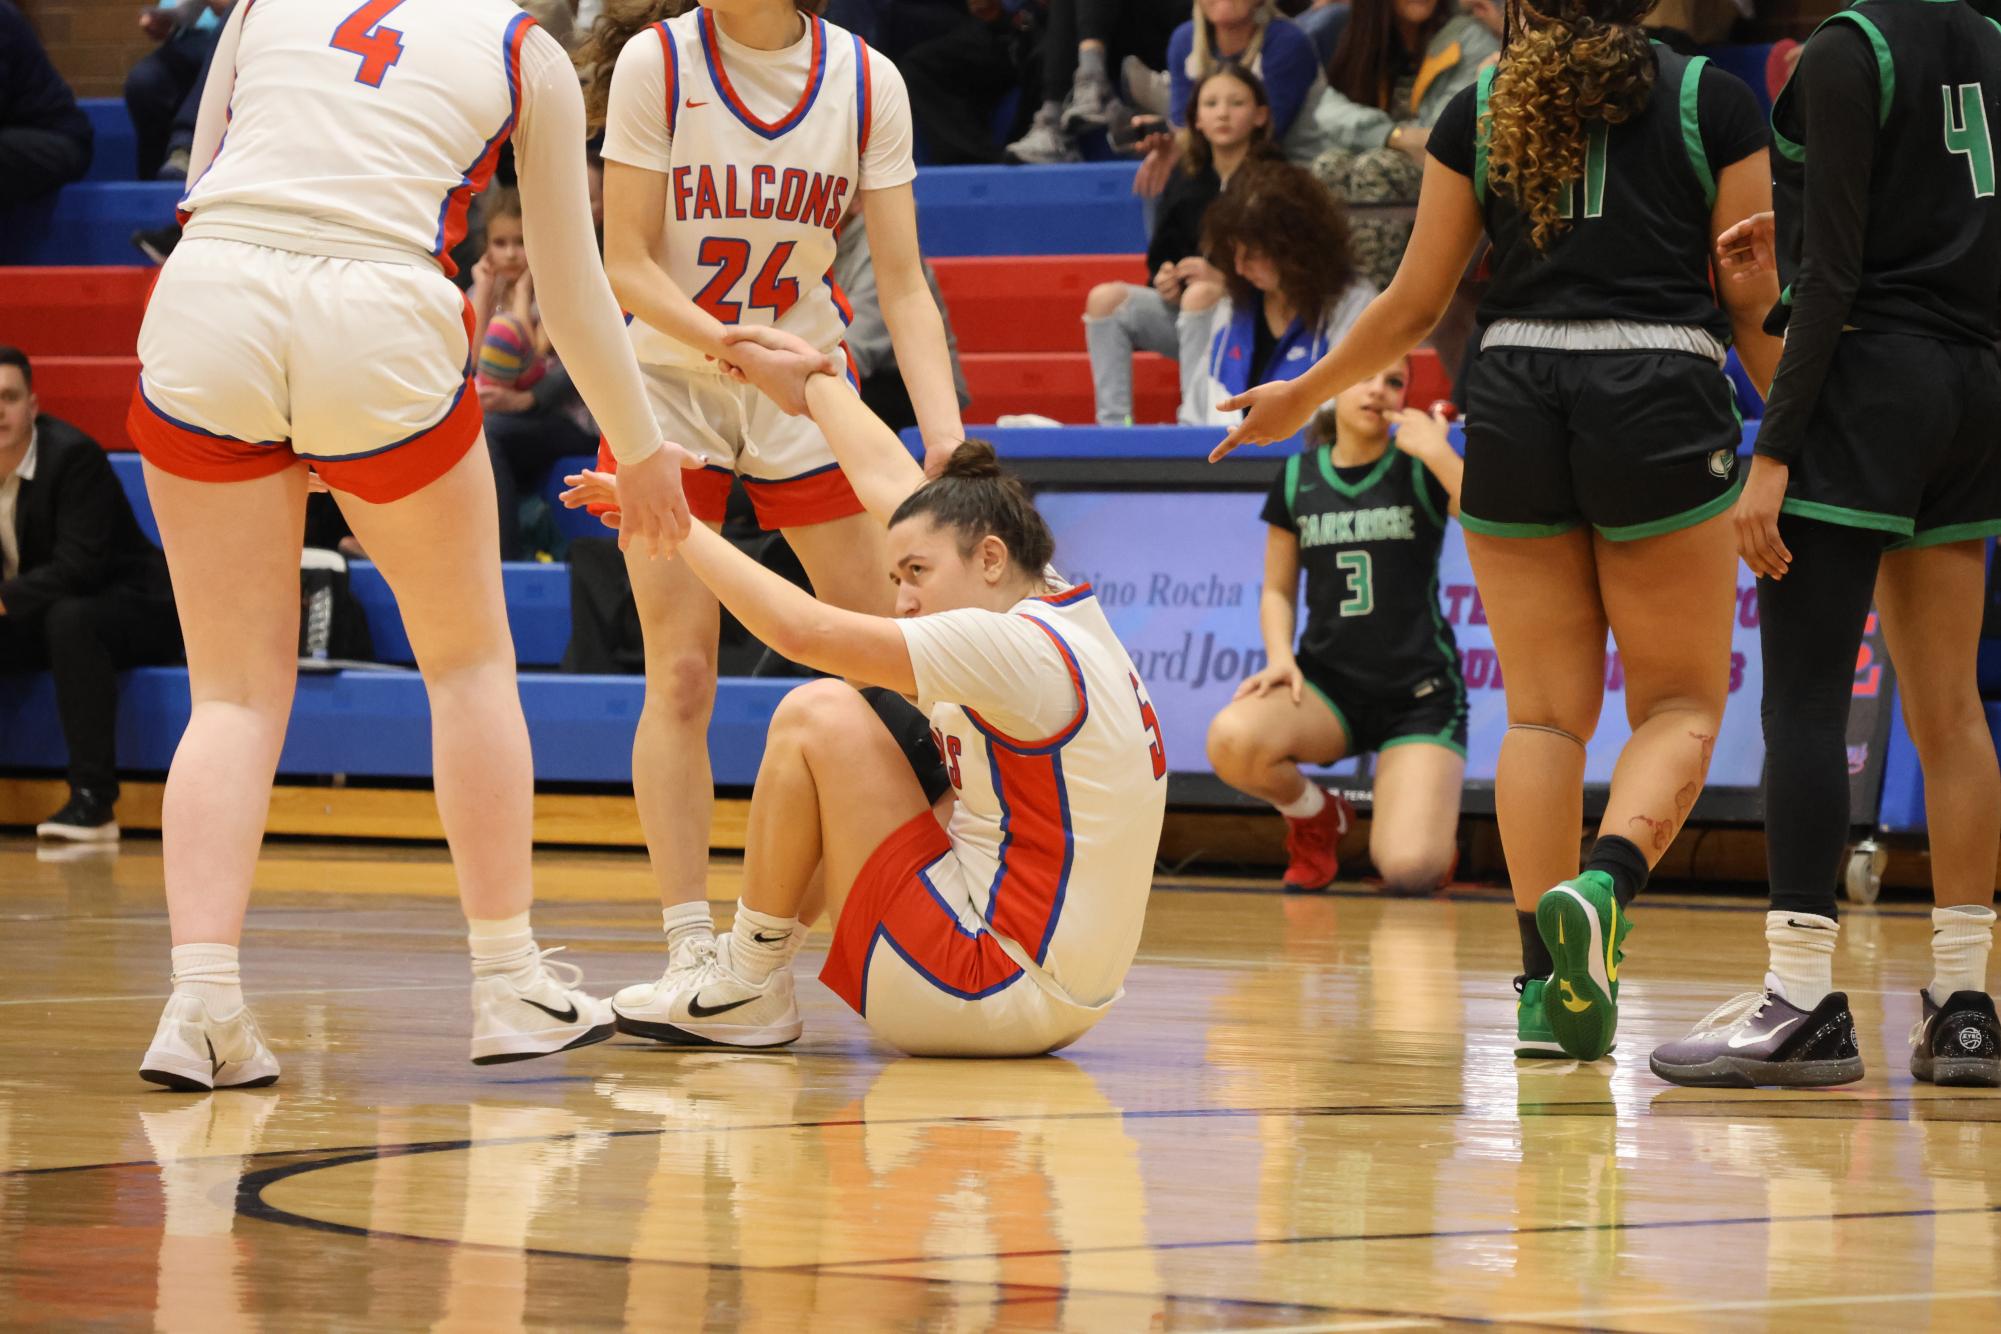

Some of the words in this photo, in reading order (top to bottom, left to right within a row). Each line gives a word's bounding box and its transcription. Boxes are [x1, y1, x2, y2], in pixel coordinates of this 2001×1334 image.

[328, 0, 406, 89] 4
[1942, 82, 1995, 198] 4
[672, 164, 849, 229] FALCONS
[692, 236, 800, 325] 24
[1148, 573, 1244, 607] Rocha
[1336, 550, 1374, 617] 3
